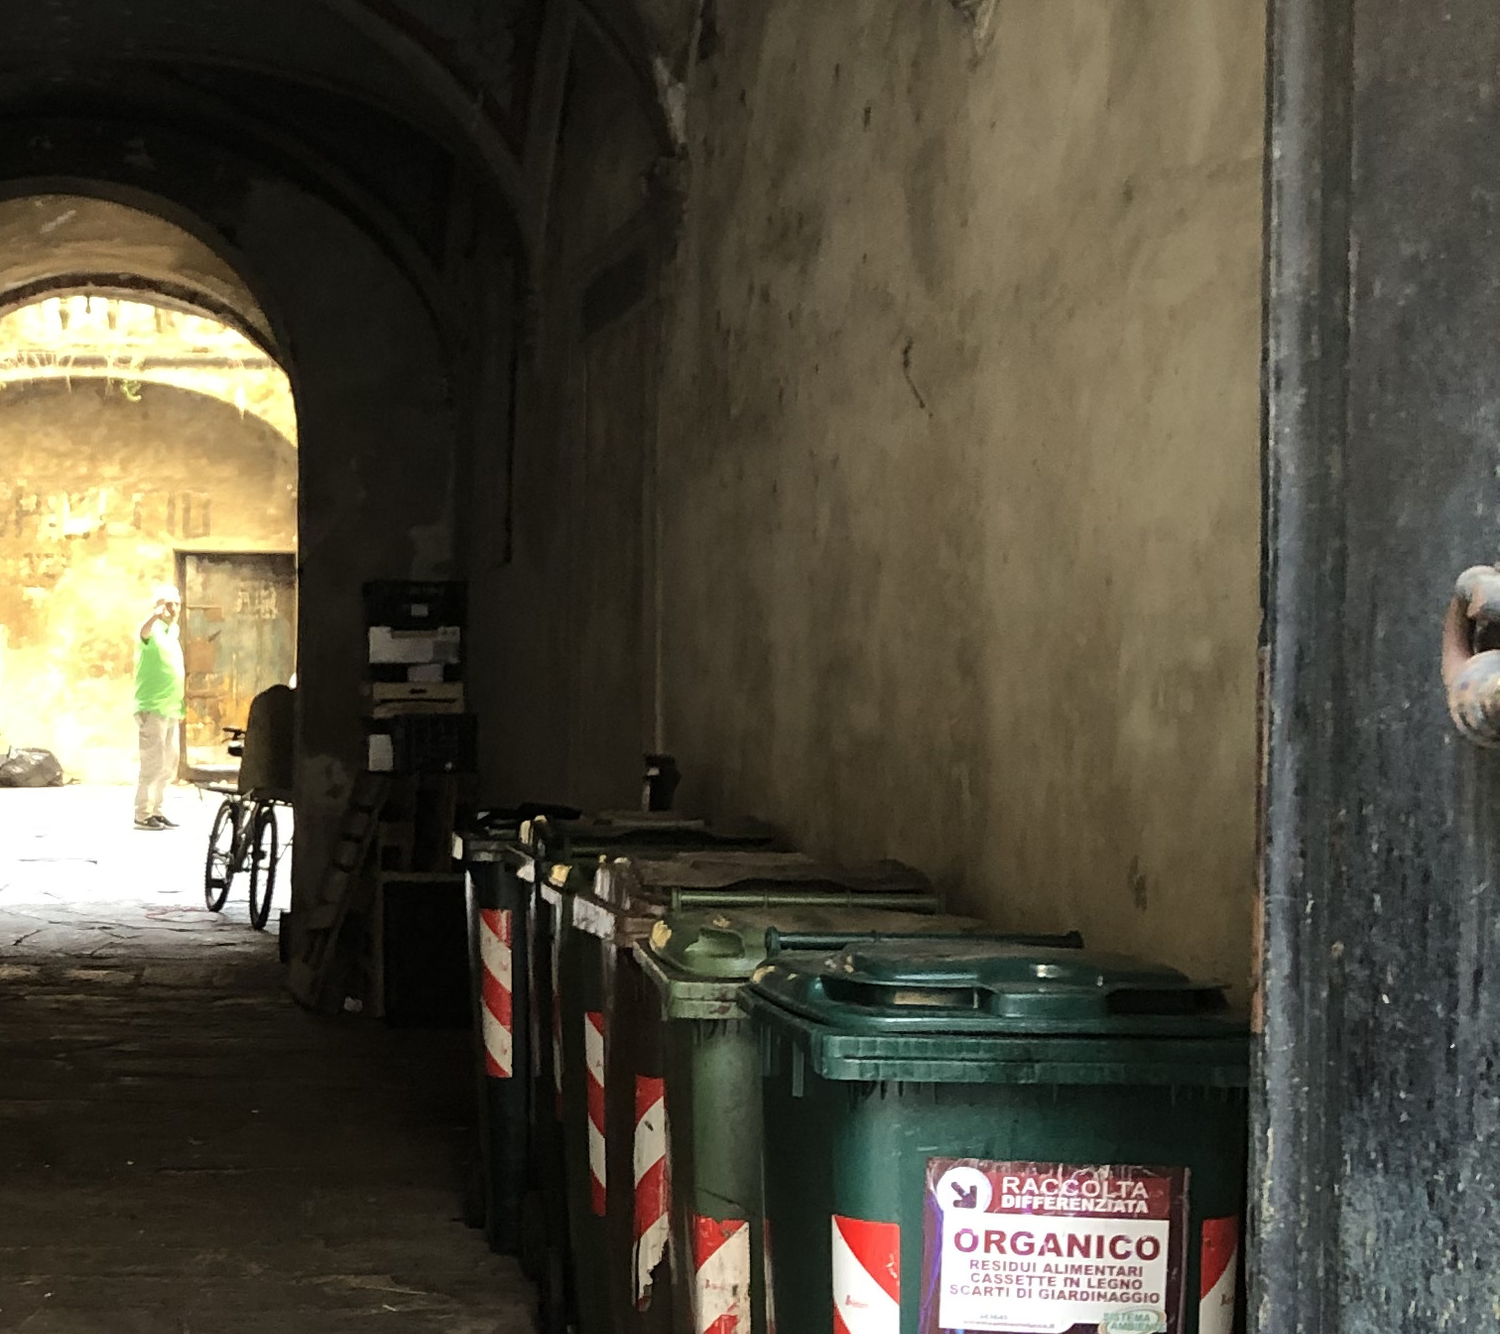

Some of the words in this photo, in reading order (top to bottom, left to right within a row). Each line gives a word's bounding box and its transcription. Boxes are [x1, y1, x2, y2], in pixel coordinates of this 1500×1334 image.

[1002, 1176, 1149, 1199] RACCOLTA
[1001, 1195, 1149, 1214] DIFFERENZIATA
[954, 1228, 1161, 1261] ORGANICO
[969, 1259, 1037, 1273] RESIDUI
[1042, 1263, 1143, 1278] ALIMENTARI
[970, 1273, 1057, 1287] CASSETTE
[1063, 1276, 1080, 1288] IN
[1087, 1277, 1143, 1290] LEGNO
[950, 1284, 1010, 1298] SCARTI
[1016, 1287, 1032, 1299] DI
[1038, 1288, 1160, 1304] GIARDINAGGIO
